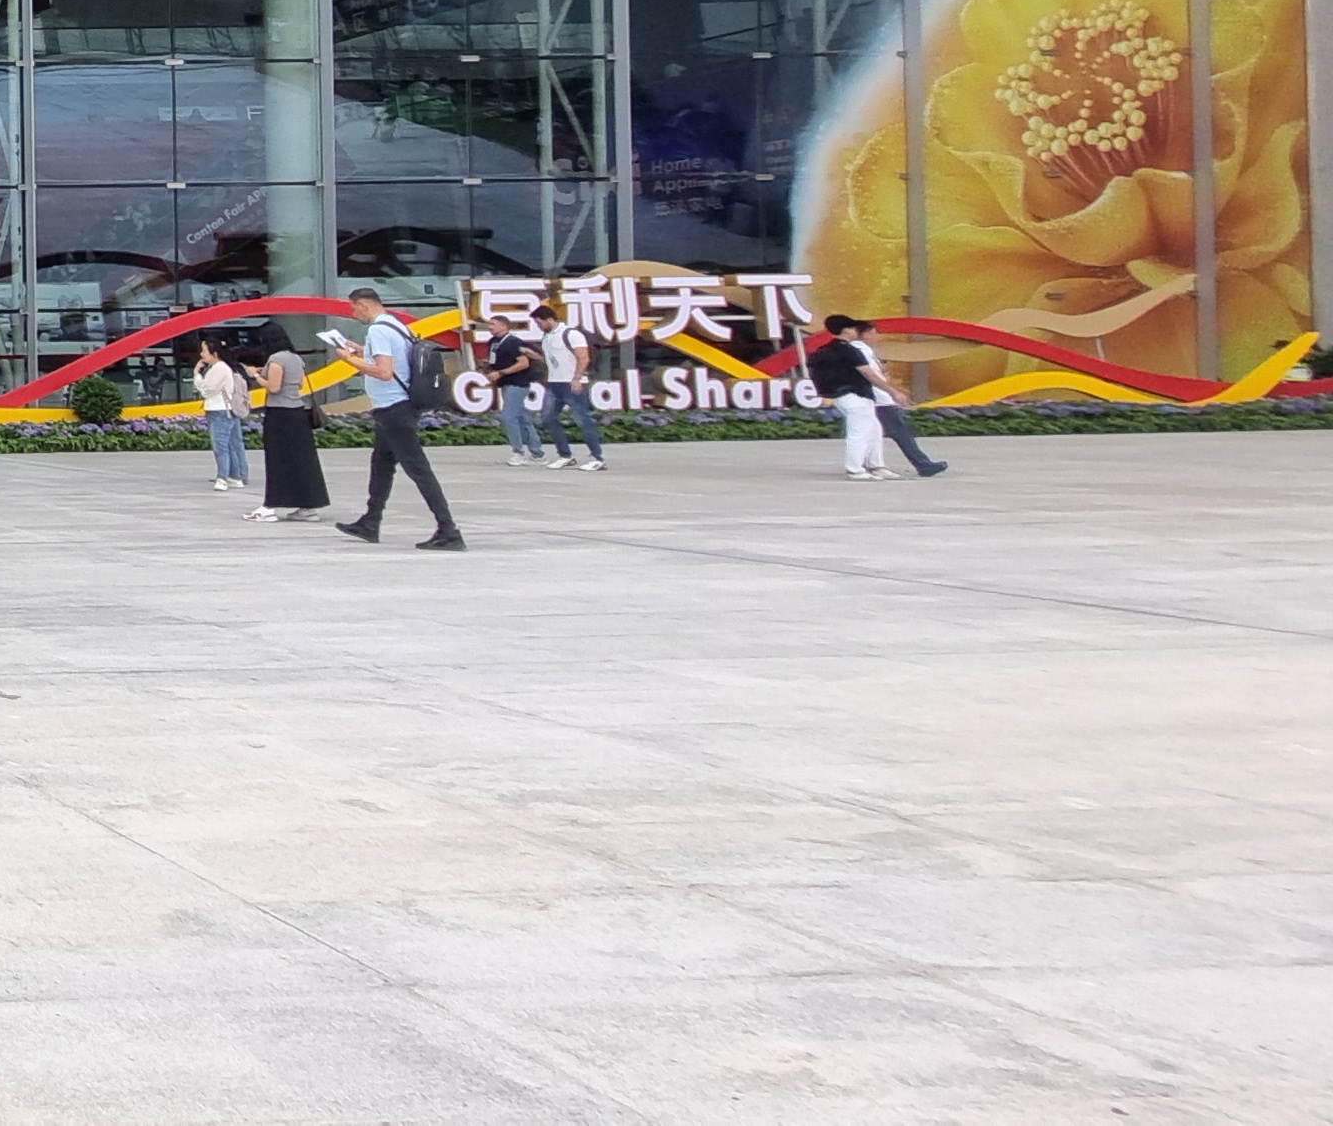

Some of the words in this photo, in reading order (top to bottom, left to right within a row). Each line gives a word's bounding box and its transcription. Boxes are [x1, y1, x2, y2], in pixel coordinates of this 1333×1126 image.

[651, 157, 703, 174] Home
[471, 274, 815, 343] 互利天下
[661, 366, 824, 411] Share
